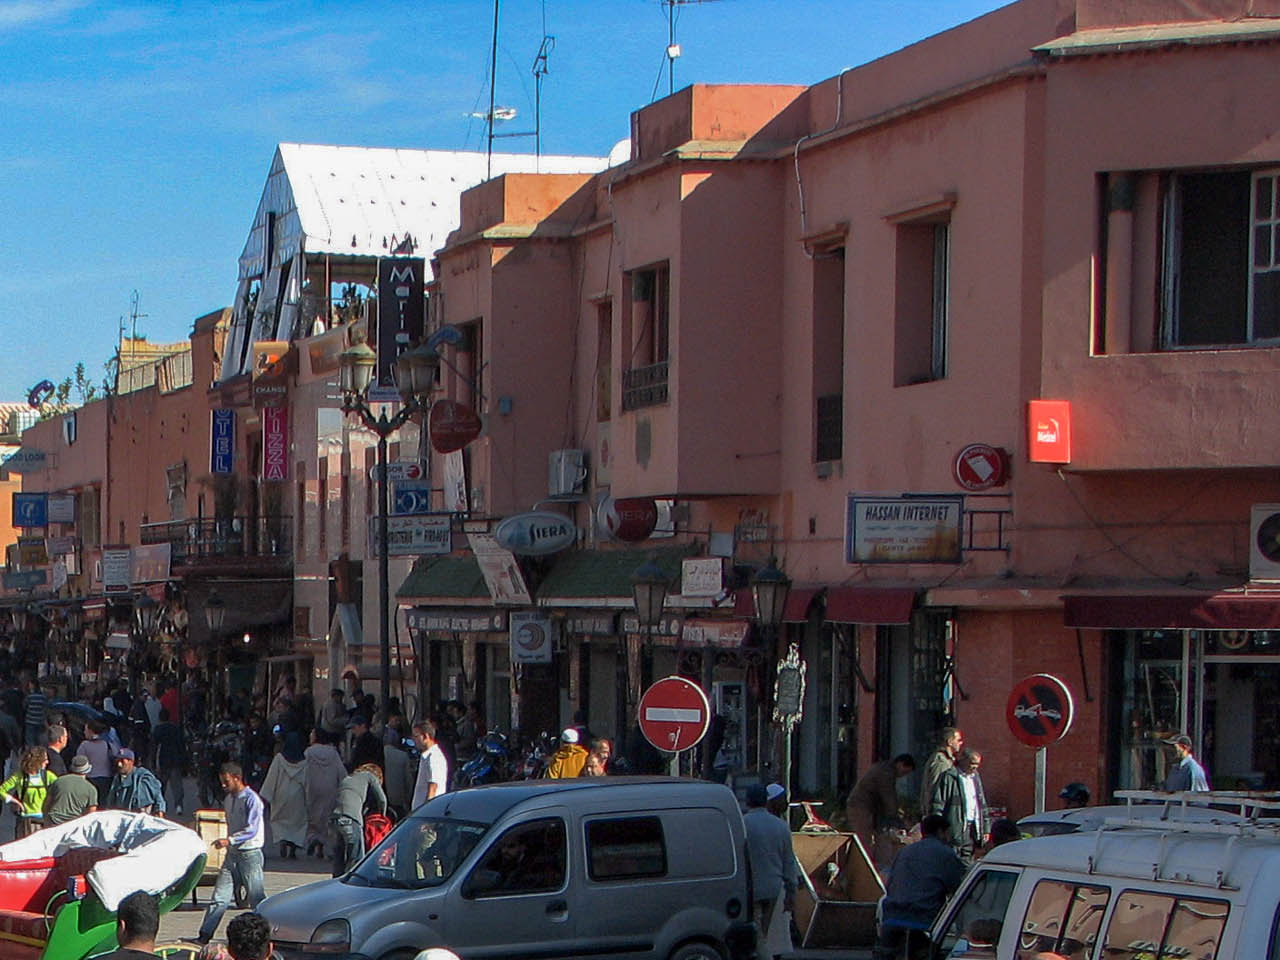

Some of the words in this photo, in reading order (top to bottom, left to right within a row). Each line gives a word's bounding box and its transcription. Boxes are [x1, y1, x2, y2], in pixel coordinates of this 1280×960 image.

[215, 408, 231, 473] OTEL
[865, 505, 901, 521] HASSAN
[903, 505, 950, 521] INTERNET
[529, 523, 568, 545] SIERA
